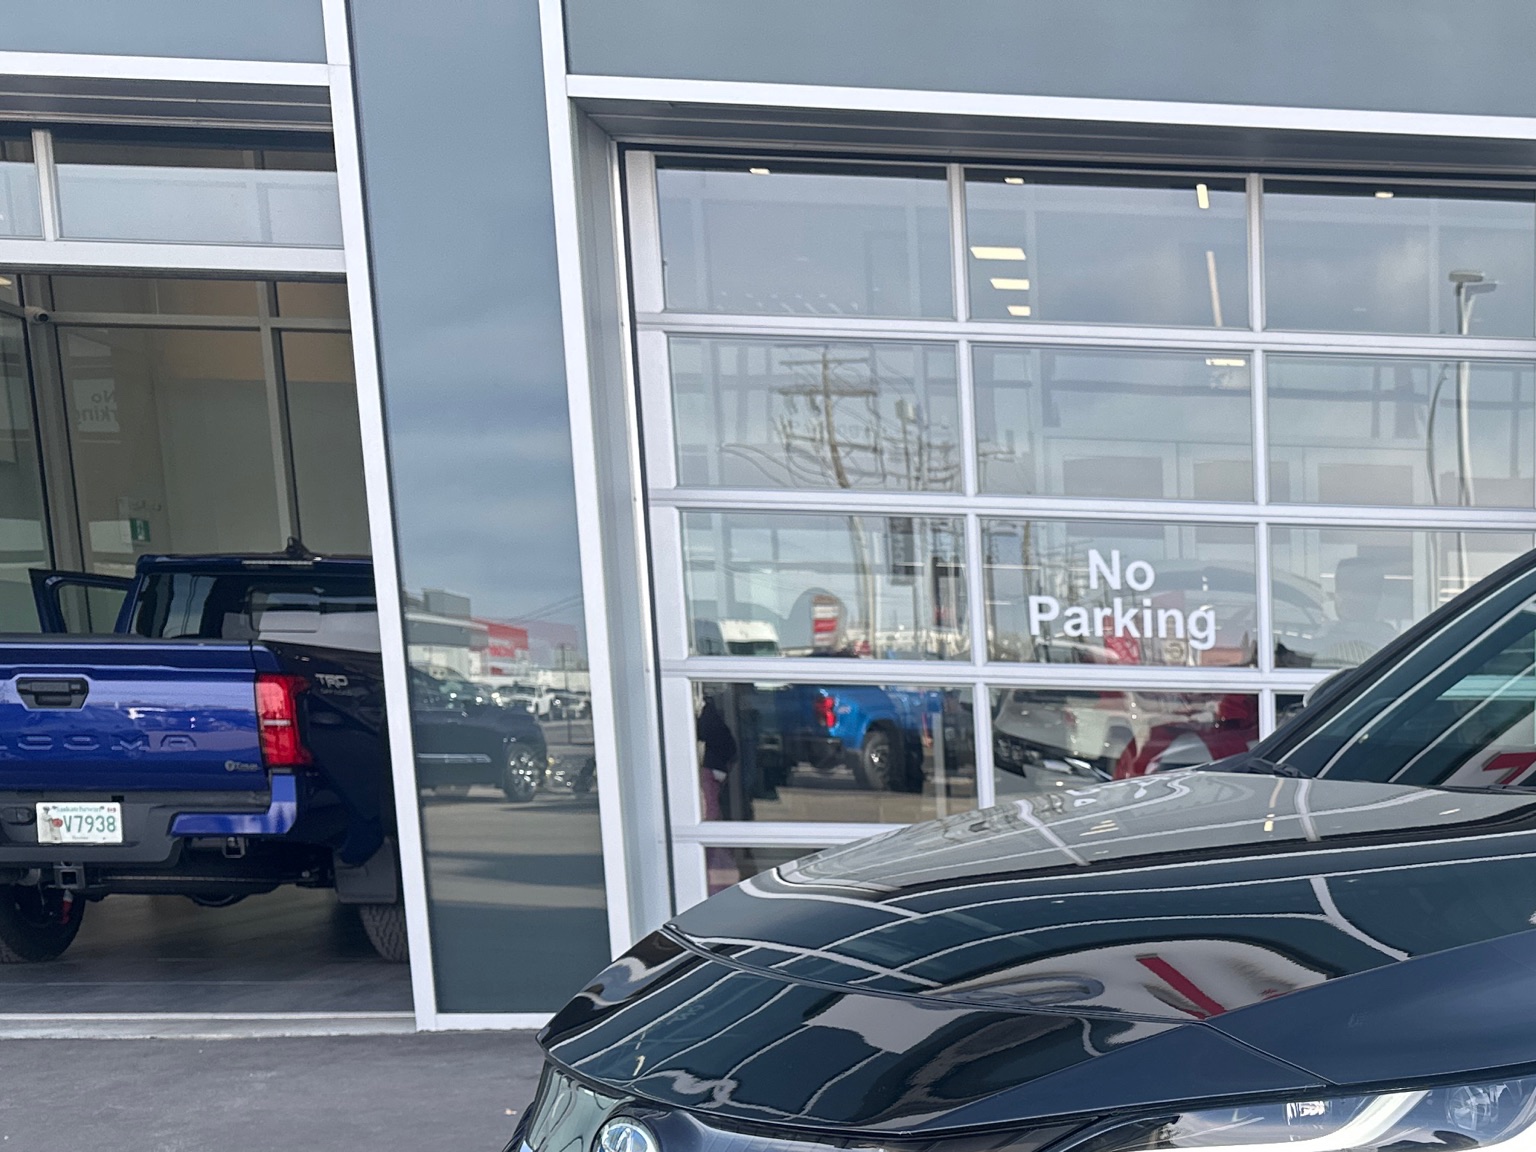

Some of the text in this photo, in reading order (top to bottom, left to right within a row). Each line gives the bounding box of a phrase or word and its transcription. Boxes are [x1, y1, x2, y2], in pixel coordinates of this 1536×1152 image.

[1088, 549, 1155, 591] No
[1028, 595, 1216, 650] Parking
[315, 673, 348, 689] TRD
[0, 734, 197, 751] COMA
[63, 815, 116, 833] V7938
